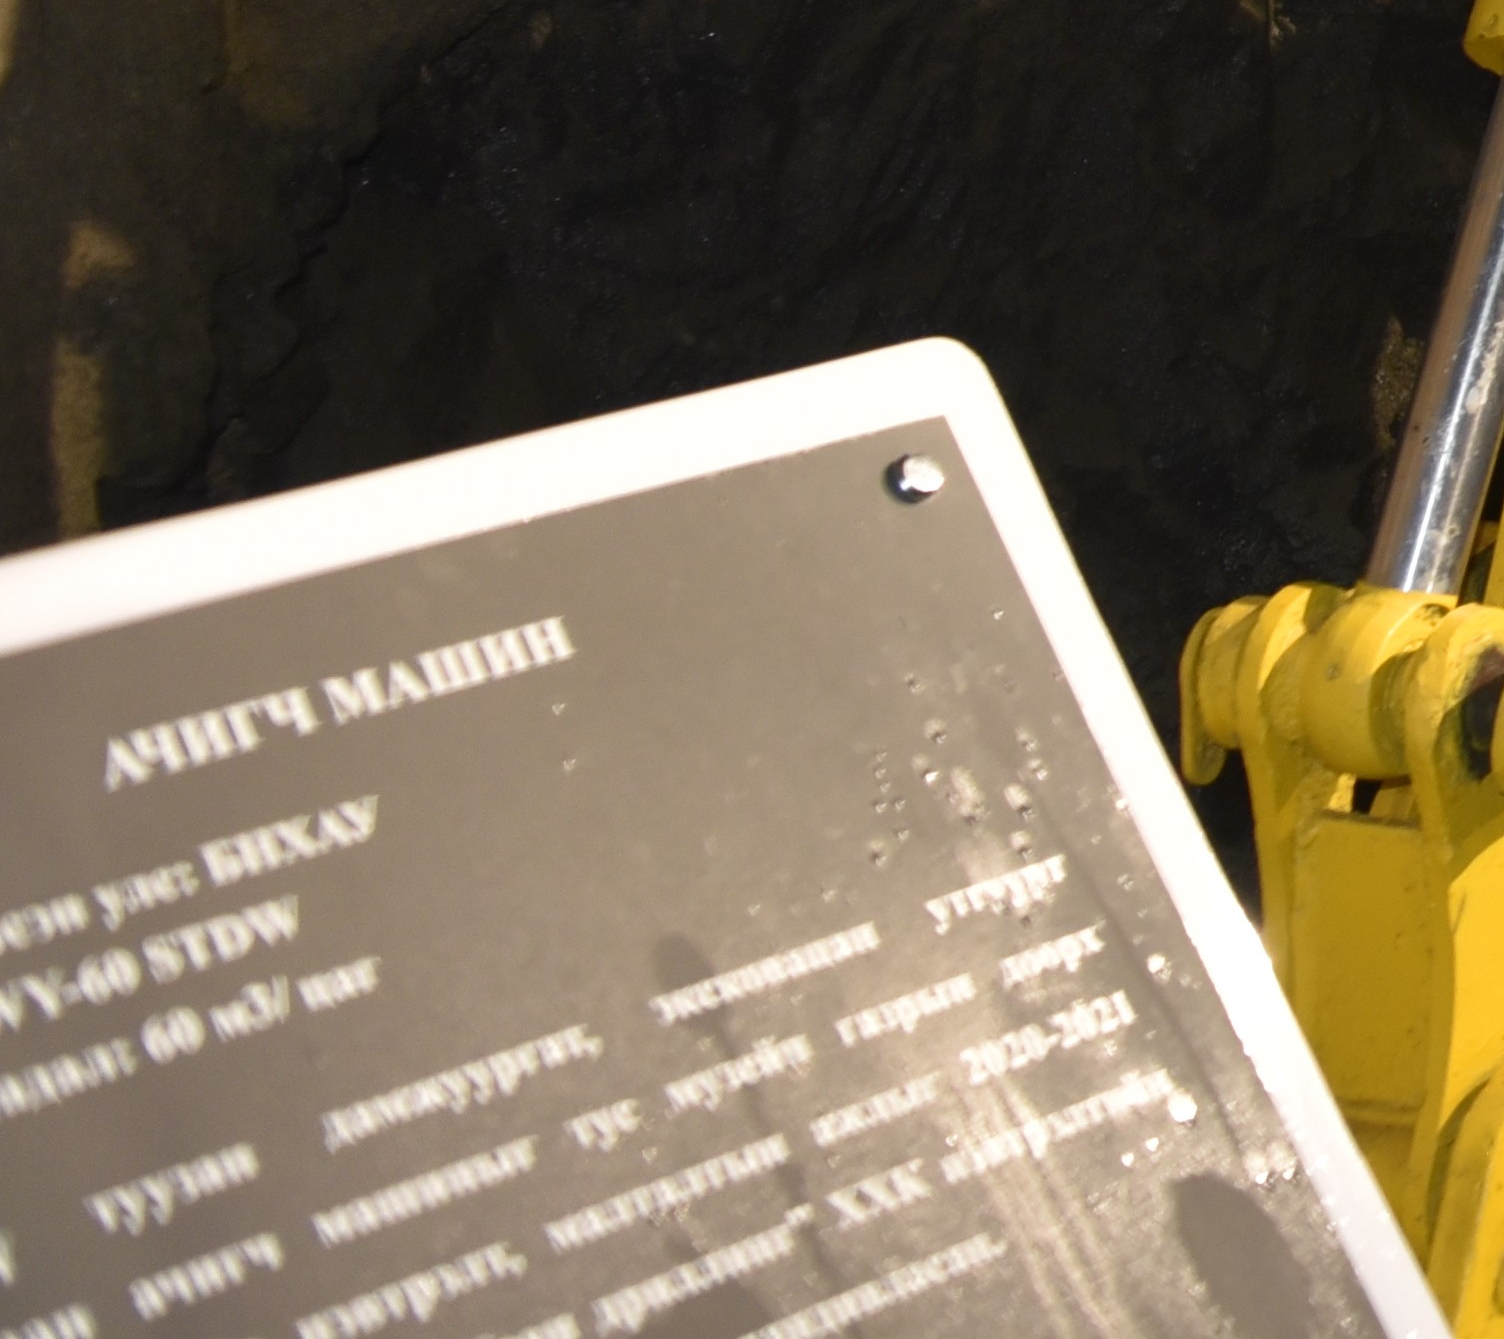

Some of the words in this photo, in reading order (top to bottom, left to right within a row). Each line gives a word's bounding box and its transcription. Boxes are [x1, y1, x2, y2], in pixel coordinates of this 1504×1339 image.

[104, 688, 316, 791] АЧИГЧ
[322, 616, 574, 724] МАШИН
[200, 795, 377, 885] БНХАУ
[142, 898, 296, 980] STDW
[141, 1009, 201, 1061] 60
[825, 1158, 929, 1230] ХХК
